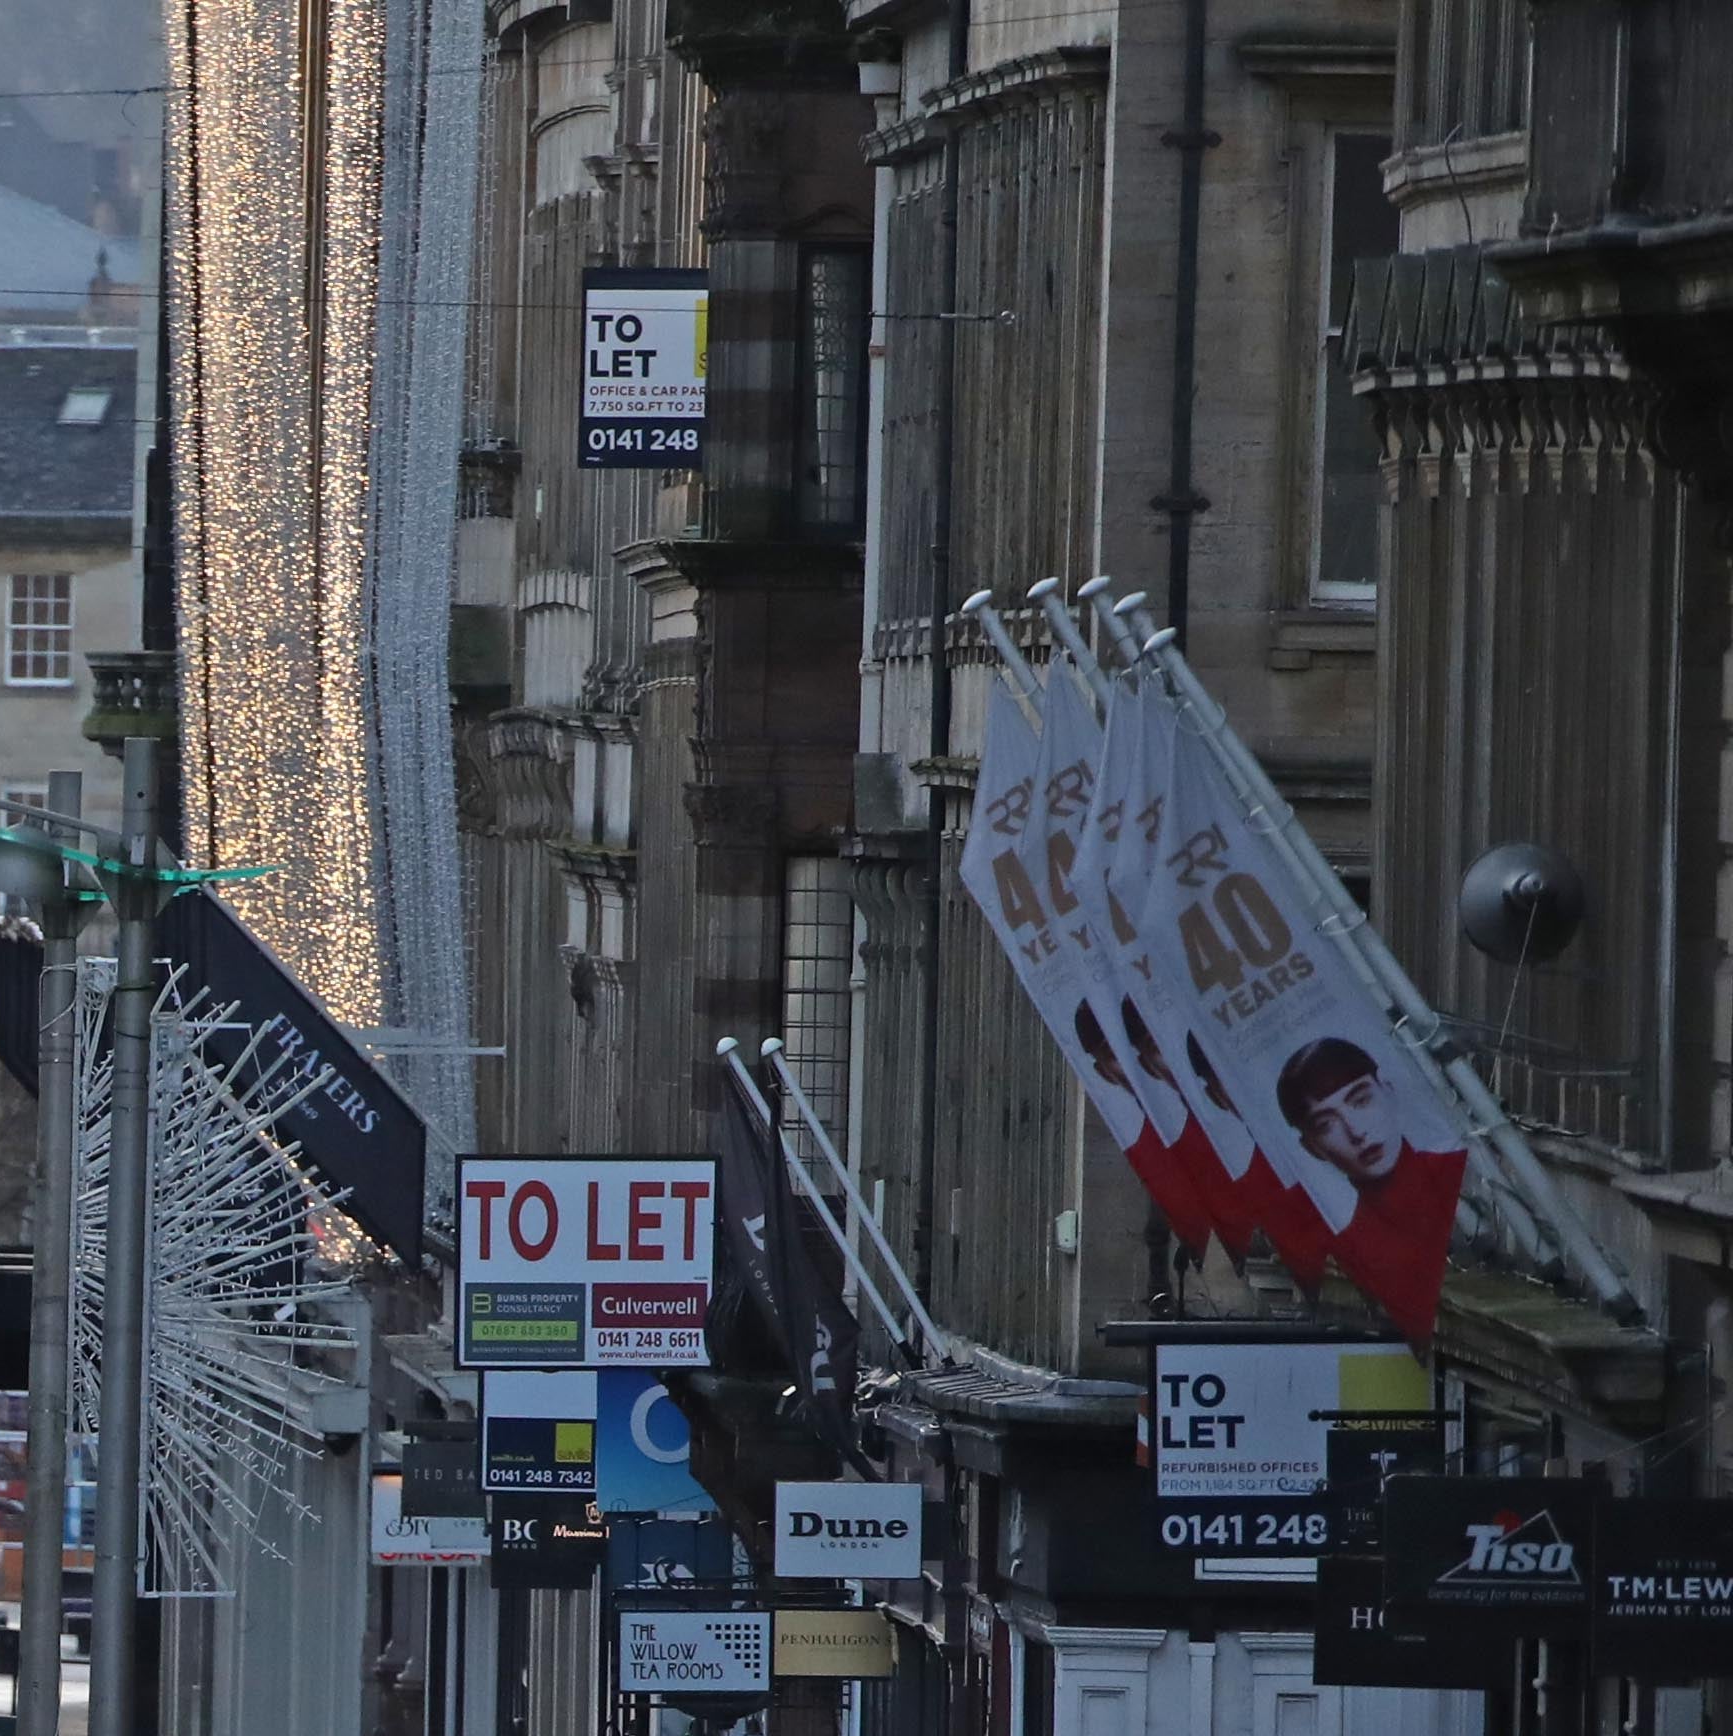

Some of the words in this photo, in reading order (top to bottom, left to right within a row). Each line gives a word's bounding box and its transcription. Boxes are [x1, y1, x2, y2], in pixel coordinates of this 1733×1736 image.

[592, 315, 642, 342] TO
[590, 350, 657, 378] LET
[590, 386, 635, 396] OFFICE
[640, 386, 647, 396] &
[652, 386, 677, 396] CAR
[589, 401, 623, 413] 7,750
[668, 402, 685, 411] TO
[589, 429, 642, 450] 0141
[650, 430, 698, 450] 248
[1178, 872, 1293, 995] 40
[1213, 951, 1315, 1025] YEARS
[466, 1180, 559, 1261] TO
[587, 1181, 709, 1261] LET
[497, 1294, 528, 1303] BURNS
[531, 1294, 579, 1303] PROPERTY
[601, 1297, 697, 1315] Culverwell
[496, 1304, 562, 1313] CONSULTANCY
[598, 1332, 629, 1347] 0141
[636, 1332, 662, 1347] 248
[669, 1332, 700, 1347] 6611
[598, 1350, 699, 1360] www.culverwell.co.uk
[1161, 1374, 1226, 1407] TO
[1161, 1415, 1245, 1449] LET
[414, 1469, 443, 1480] TED
[1161, 1462, 1256, 1473] REFURBISHED
[1261, 1462, 1319, 1473] OFFICES
[490, 1470, 520, 1483] 0141
[526, 1471, 553, 1483] 248
[557, 1471, 592, 1484] 7342
[1161, 1479, 1201, 1490] FROM
[553, 1524, 603, 1538] Massimo
[788, 1511, 908, 1538] Dune
[1162, 1515, 1243, 1545] 0141
[1255, 1515, 1328, 1545] 248
[820, 1541, 879, 1549] LONDON
[1465, 1523, 1574, 1574] Tiso
[1607, 1604, 1668, 1616] JERMYN
[630, 1624, 656, 1641] THE
[630, 1643, 697, 1660] WILLOW
[630, 1662, 660, 1679] TEA
[667, 1662, 723, 1679] ROOMS
